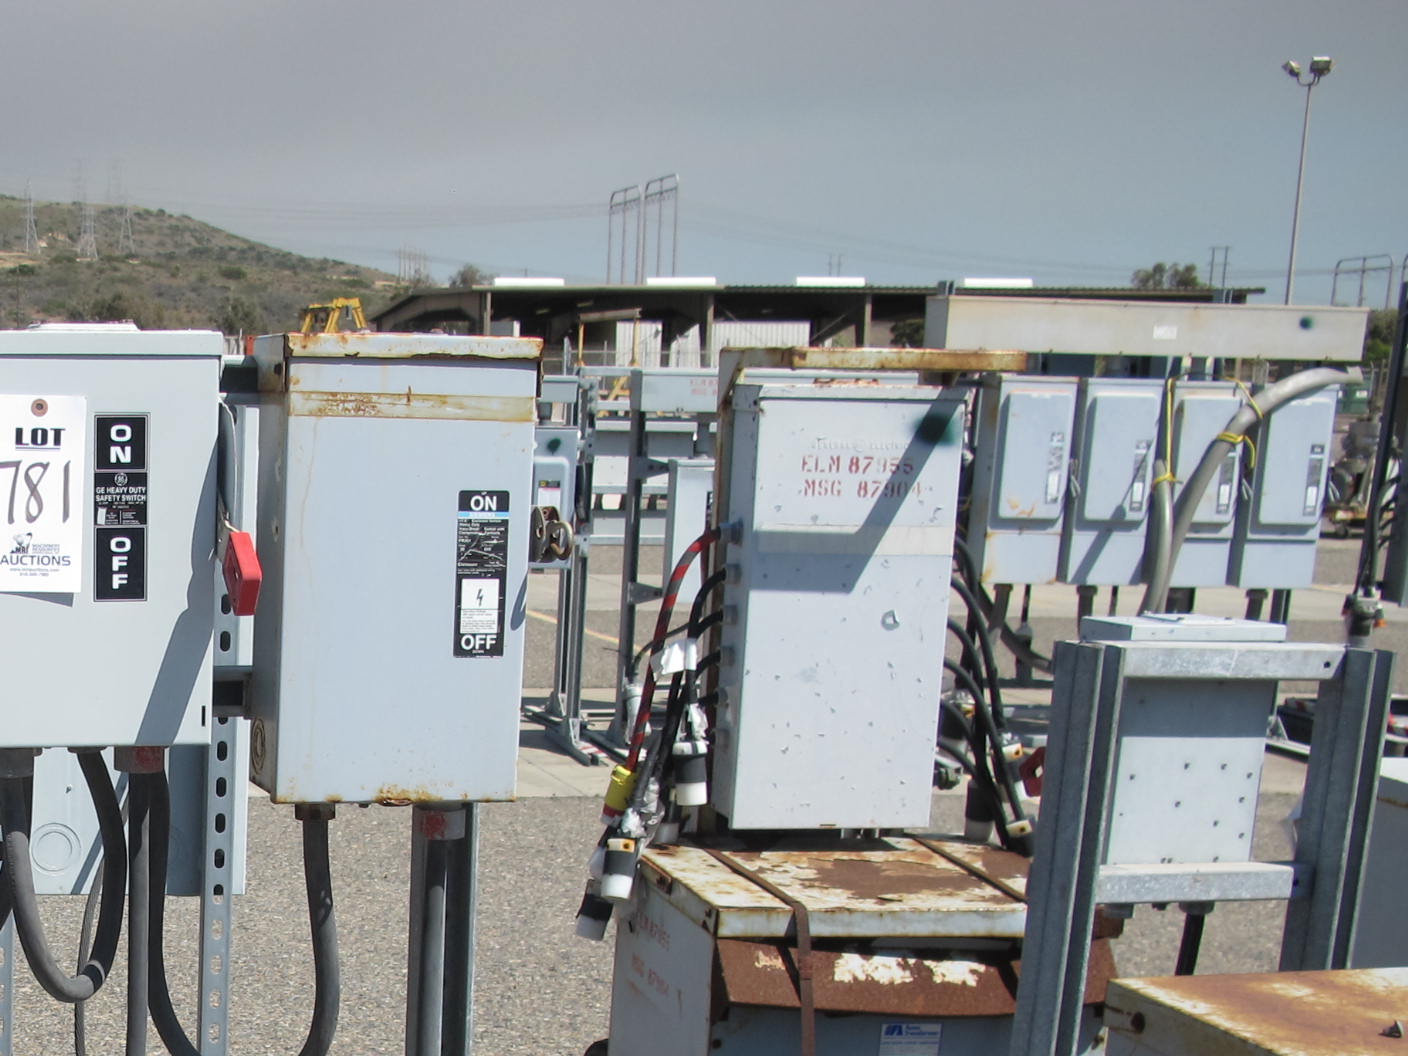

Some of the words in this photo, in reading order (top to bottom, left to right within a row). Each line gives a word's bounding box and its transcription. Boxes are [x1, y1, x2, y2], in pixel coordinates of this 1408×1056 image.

[15, 427, 66, 447] LOT
[109, 424, 132, 464] ON
[800, 455, 841, 474] ELM
[95, 494, 121, 502] SAFETY
[121, 494, 146, 502] SWITCH
[803, 479, 843, 498] MSG
[470, 496, 497, 512] ON
[0, 555, 72, 567] AUCTIONS
[109, 537, 132, 590] OFF
[460, 635, 498, 650] OFF
